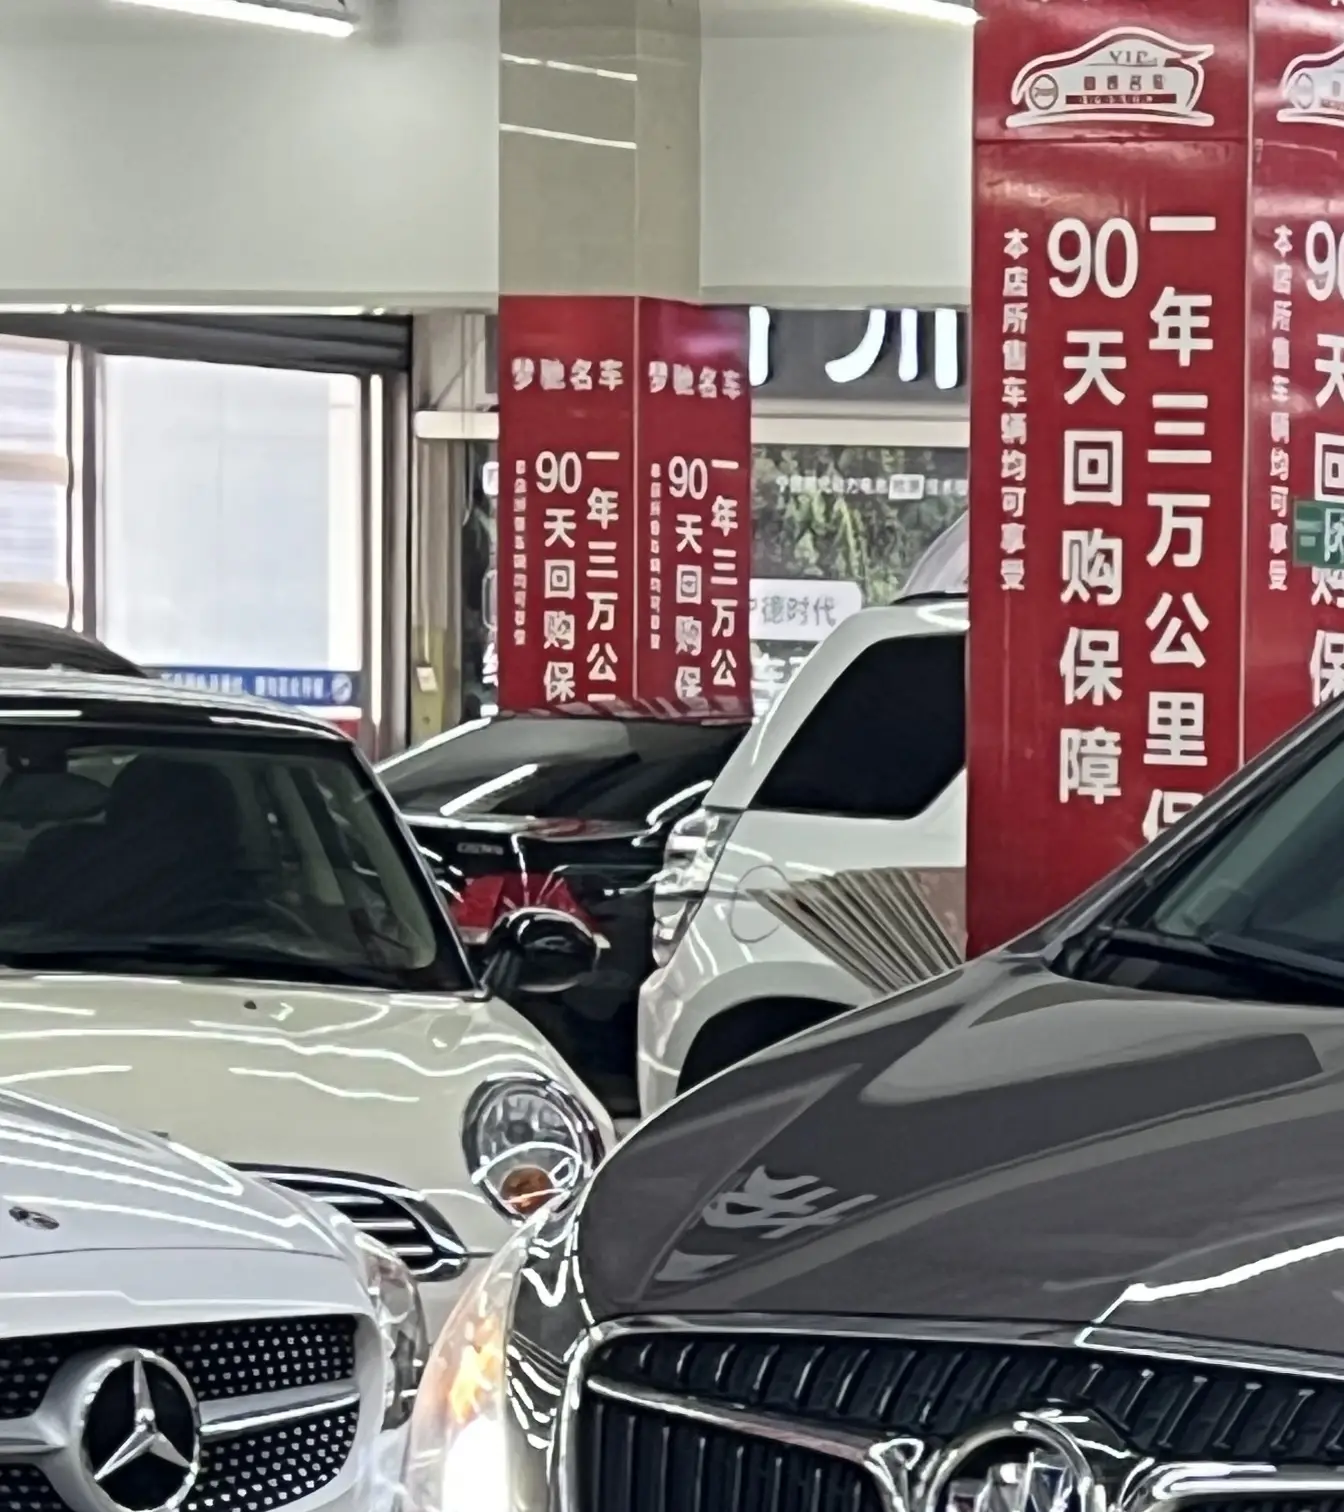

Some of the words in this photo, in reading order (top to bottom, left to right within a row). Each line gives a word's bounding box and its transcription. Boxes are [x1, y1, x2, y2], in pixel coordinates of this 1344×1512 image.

[585, 450, 621, 702] 一年三万公
[1047, 216, 1140, 805] 90天回购保障
